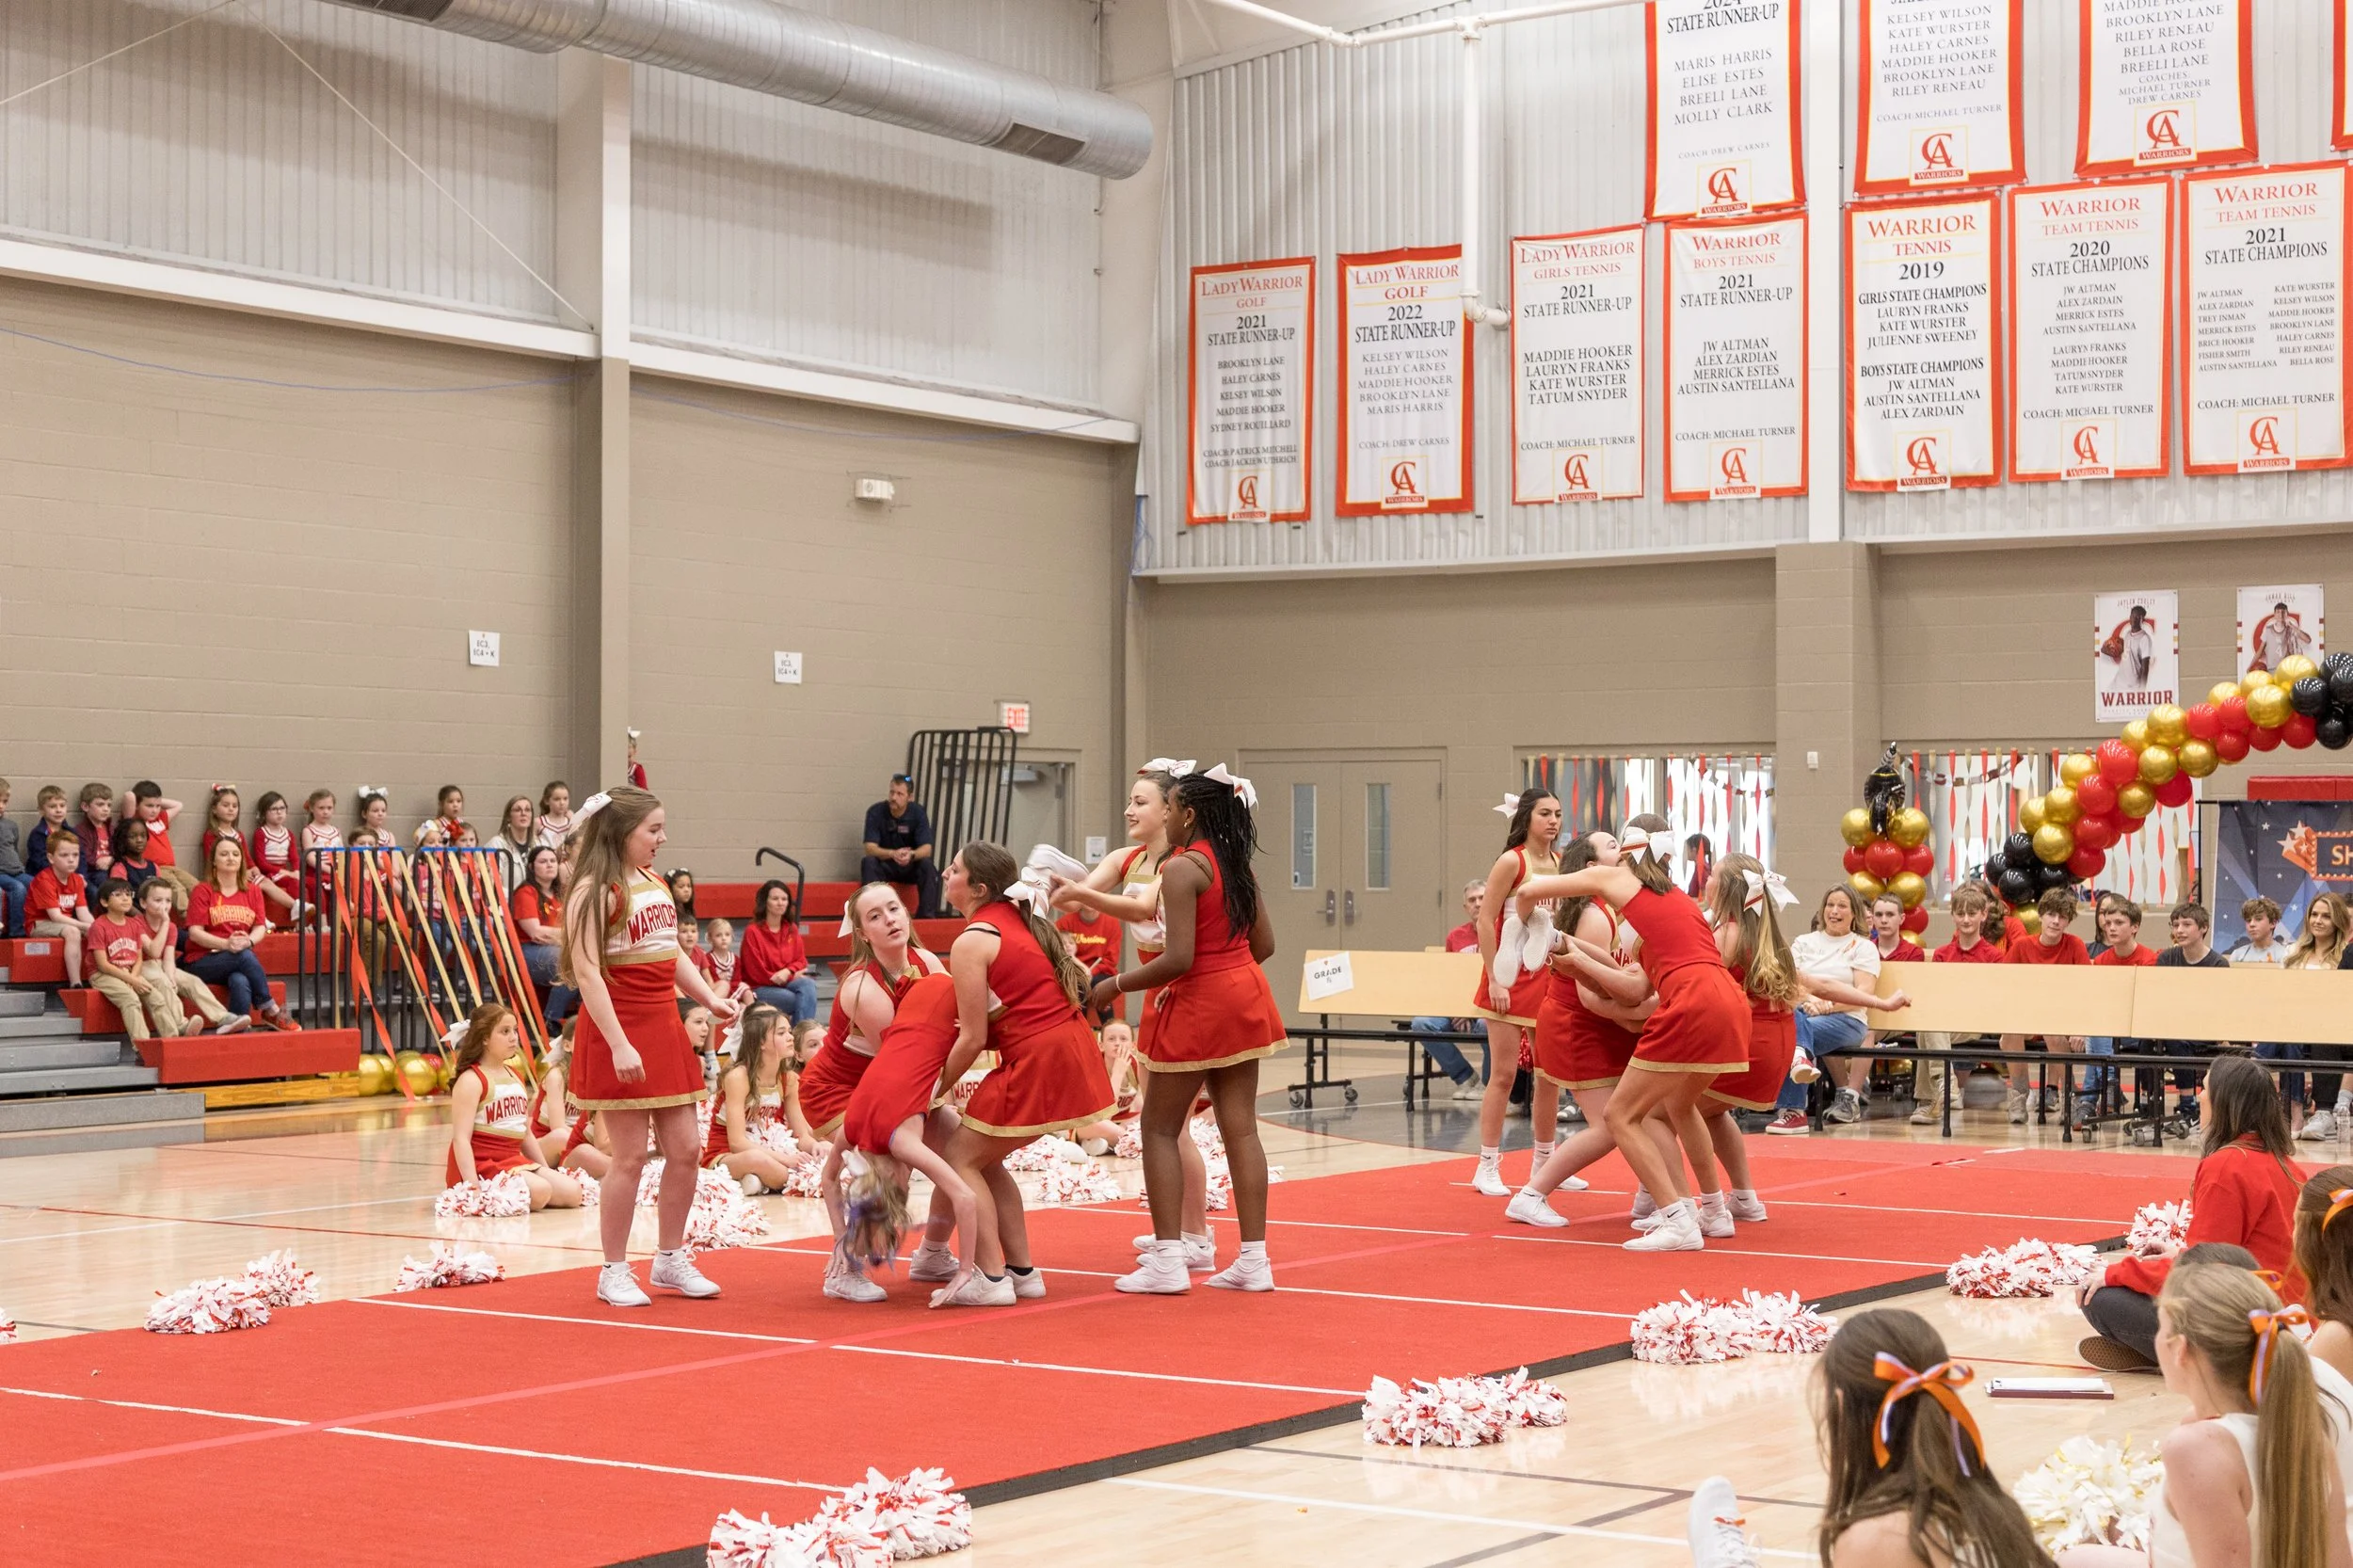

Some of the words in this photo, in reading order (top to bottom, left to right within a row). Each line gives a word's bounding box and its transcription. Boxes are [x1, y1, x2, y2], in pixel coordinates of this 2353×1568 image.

[1668, 14, 1704, 34] STATE
[1707, 3, 1779, 27] RUNNER-UP
[1887, 11, 1934, 24] KELSEY
[1940, 5, 1992, 18] WILSON
[2106, 10, 2182, 27] BROOKLYN
[2187, 5, 2224, 18] LANE
[1888, 27, 1922, 40] KATE
[1927, 21, 1991, 35] WURSTER
[2116, 29, 2153, 42] RILEY
[2159, 23, 2214, 38] RENEAU
[1890, 41, 1932, 54] HALEY
[1937, 35, 1989, 49] CARNES
[2123, 45, 2167, 57] BELLA
[2171, 39, 2205, 52] ROSE
[1674, 56, 1715, 72] MARIS
[1722, 48, 1772, 65] HARRIS
[1882, 56, 1934, 69] MADDIE
[1939, 49, 1997, 64] HOOKER
[2121, 59, 2168, 73] BREELI
[2172, 55, 2209, 68] LANE
[1683, 73, 1717, 88] ELISE
[1725, 67, 1764, 83] ESTES
[1883, 68, 1956, 83] BROOKLYN
[1960, 64, 1995, 76] LANE
[1680, 90, 1724, 106] BREELI
[1732, 85, 1768, 99] LANE
[1892, 85, 1929, 97] RILEY
[1933, 79, 1986, 93] RENEAU
[1674, 109, 1721, 125] MOLLY
[1727, 102, 1773, 119] CLARK
[2140, 149, 2191, 160] WARRIORS
[1916, 170, 1962, 180] WARRIORS
[2214, 183, 2318, 204] WARRIOR
[1703, 204, 1747, 214] WARRIORS
[2041, 198, 2140, 217] WARRIOR
[2217, 210, 2257, 223] TEAM
[2262, 204, 2316, 218] TENNIS
[1867, 215, 1977, 238] WARRIOR
[2042, 222, 2082, 236] TEAM
[2086, 218, 2138, 232] TENNIS
[1692, 232, 1781, 250] WARRIOR
[2246, 228, 2285, 245] 2021
[1521, 248, 1561, 264] LADY
[1562, 242, 1635, 259] WARRIOR
[1893, 239, 1951, 256] TENNIS
[2070, 241, 2110, 258] 2020
[2205, 248, 2245, 265] STATE
[2248, 241, 2328, 262] CHAMPIONS
[1694, 257, 1726, 269] BOYS
[1729, 252, 1775, 266] TENNIS
[2031, 261, 2070, 278] STATE
[2073, 255, 2149, 274] CHAMPIONS
[1355, 270, 1391, 284] LADY
[1395, 264, 1459, 280] WARRIOR
[1534, 266, 1570, 279] GIRLS
[1574, 263, 1621, 276] TENNIS
[1898, 261, 1945, 280] 2019
[1202, 280, 1238, 296] LADY
[1240, 277, 1303, 292] WARRIOR
[1719, 274, 1753, 290] 2021
[2063, 285, 2075, 296] JW
[2077, 283, 2116, 294] ALTMAN
[1385, 286, 1429, 299] GOLF
[1561, 284, 1593, 299] 2021
[1680, 292, 1718, 308] STATE
[1721, 286, 1793, 305] RUNNER-UP
[1859, 292, 1887, 305] GIRLS
[1889, 289, 1921, 302] STATE
[1923, 283, 1987, 300] CHAMPIONS
[1237, 297, 1267, 309] GOLF
[1525, 303, 1560, 318] STATE
[1562, 296, 1632, 315] RUNNER-UP
[1878, 305, 1921, 318] LAURYN
[1924, 302, 1969, 315] FRANKS
[2057, 298, 2079, 308] ALEX
[1387, 305, 1422, 321] 2022
[2199, 314, 2217, 324] TREY
[2219, 312, 2246, 322] INMAN
[1237, 315, 1266, 329] 2021
[1880, 320, 1907, 332] KATE
[1910, 316, 1966, 330] WURSTER
[2042, 324, 2075, 335] AUSTIN
[2078, 322, 2137, 333] SANTELLANA
[1208, 332, 1237, 346] STATE
[1240, 328, 1295, 344] RUNNER-UP
[1355, 325, 1389, 343] STATE
[1391, 320, 1455, 340] RUNNER-UP
[1867, 334, 1922, 350] JULIENNE
[1925, 329, 1977, 344] SWEENEY
[1525, 348, 1575, 363] MADDIE
[1578, 344, 1632, 359] HOOKER
[1704, 341, 1718, 354] JW
[1721, 337, 1769, 350] ALTMAN
[1363, 351, 1402, 362] KELSEY
[1404, 348, 1449, 360] WILSON
[1695, 354, 1722, 366] ALEX
[1726, 350, 1777, 364] ZARDIAN
[2199, 350, 2224, 360] FISHER
[2226, 349, 2250, 359] SMITH
[1365, 365, 1401, 376] HALEY
[1403, 361, 1446, 373] CARNES
[1526, 362, 1577, 376] LAURYN
[1581, 359, 1630, 373] FRANKS
[1693, 366, 1744, 380] MERRICK
[1747, 364, 1779, 376] ESTES
[1861, 364, 1885, 376] BOYS
[1887, 361, 1918, 376] STATE
[1920, 358, 1984, 374] CHAMPIONS
[1358, 377, 1401, 389] MADDIE
[1404, 375, 1452, 386] HOOKER
[1529, 377, 1562, 391] KATE
[1566, 374, 1626, 388] WURSTER
[1677, 381, 1719, 395] AUSTIN
[1721, 377, 1795, 392] SANTELLANA
[1887, 380, 1905, 393] JW
[1908, 376, 1955, 390] ALTMAN
[2056, 384, 2079, 394] KATE
[2081, 383, 2122, 392] WURSTER
[1359, 391, 1419, 402] BROOKLYN
[1422, 388, 1450, 398] LANE
[1529, 392, 1574, 405] TATUM
[1577, 388, 1627, 402] SNYDER
[1865, 393, 1904, 407] AUSTIN
[1907, 389, 1980, 404] SANTELLANA
[2197, 399, 2238, 409] COACH:
[2241, 396, 2290, 407] MICHAEL
[2292, 392, 2335, 404] TURNER
[1367, 405, 1401, 415] MARIS
[1403, 402, 1444, 412] HARRIS
[1881, 408, 1910, 420] ALEX
[1913, 405, 1964, 418] ZARDAIN
[2024, 408, 2063, 419] COACH:
[2065, 406, 2109, 417] MICHAEL
[2112, 405, 2153, 414] TURNER
[1675, 431, 1712, 441] COACH:
[1713, 428, 1756, 440] MICHAEL
[1759, 426, 1796, 436] TURNER
[1557, 438, 1596, 449] MICHAEL
[1599, 436, 1636, 445] TURNER
[2244, 458, 2289, 468] WARRIORS
[1903, 476, 1946, 486] WARRIORS
[2102, 690, 2172, 707] WARRIOR
[1314, 967, 1342, 979] GRADE
